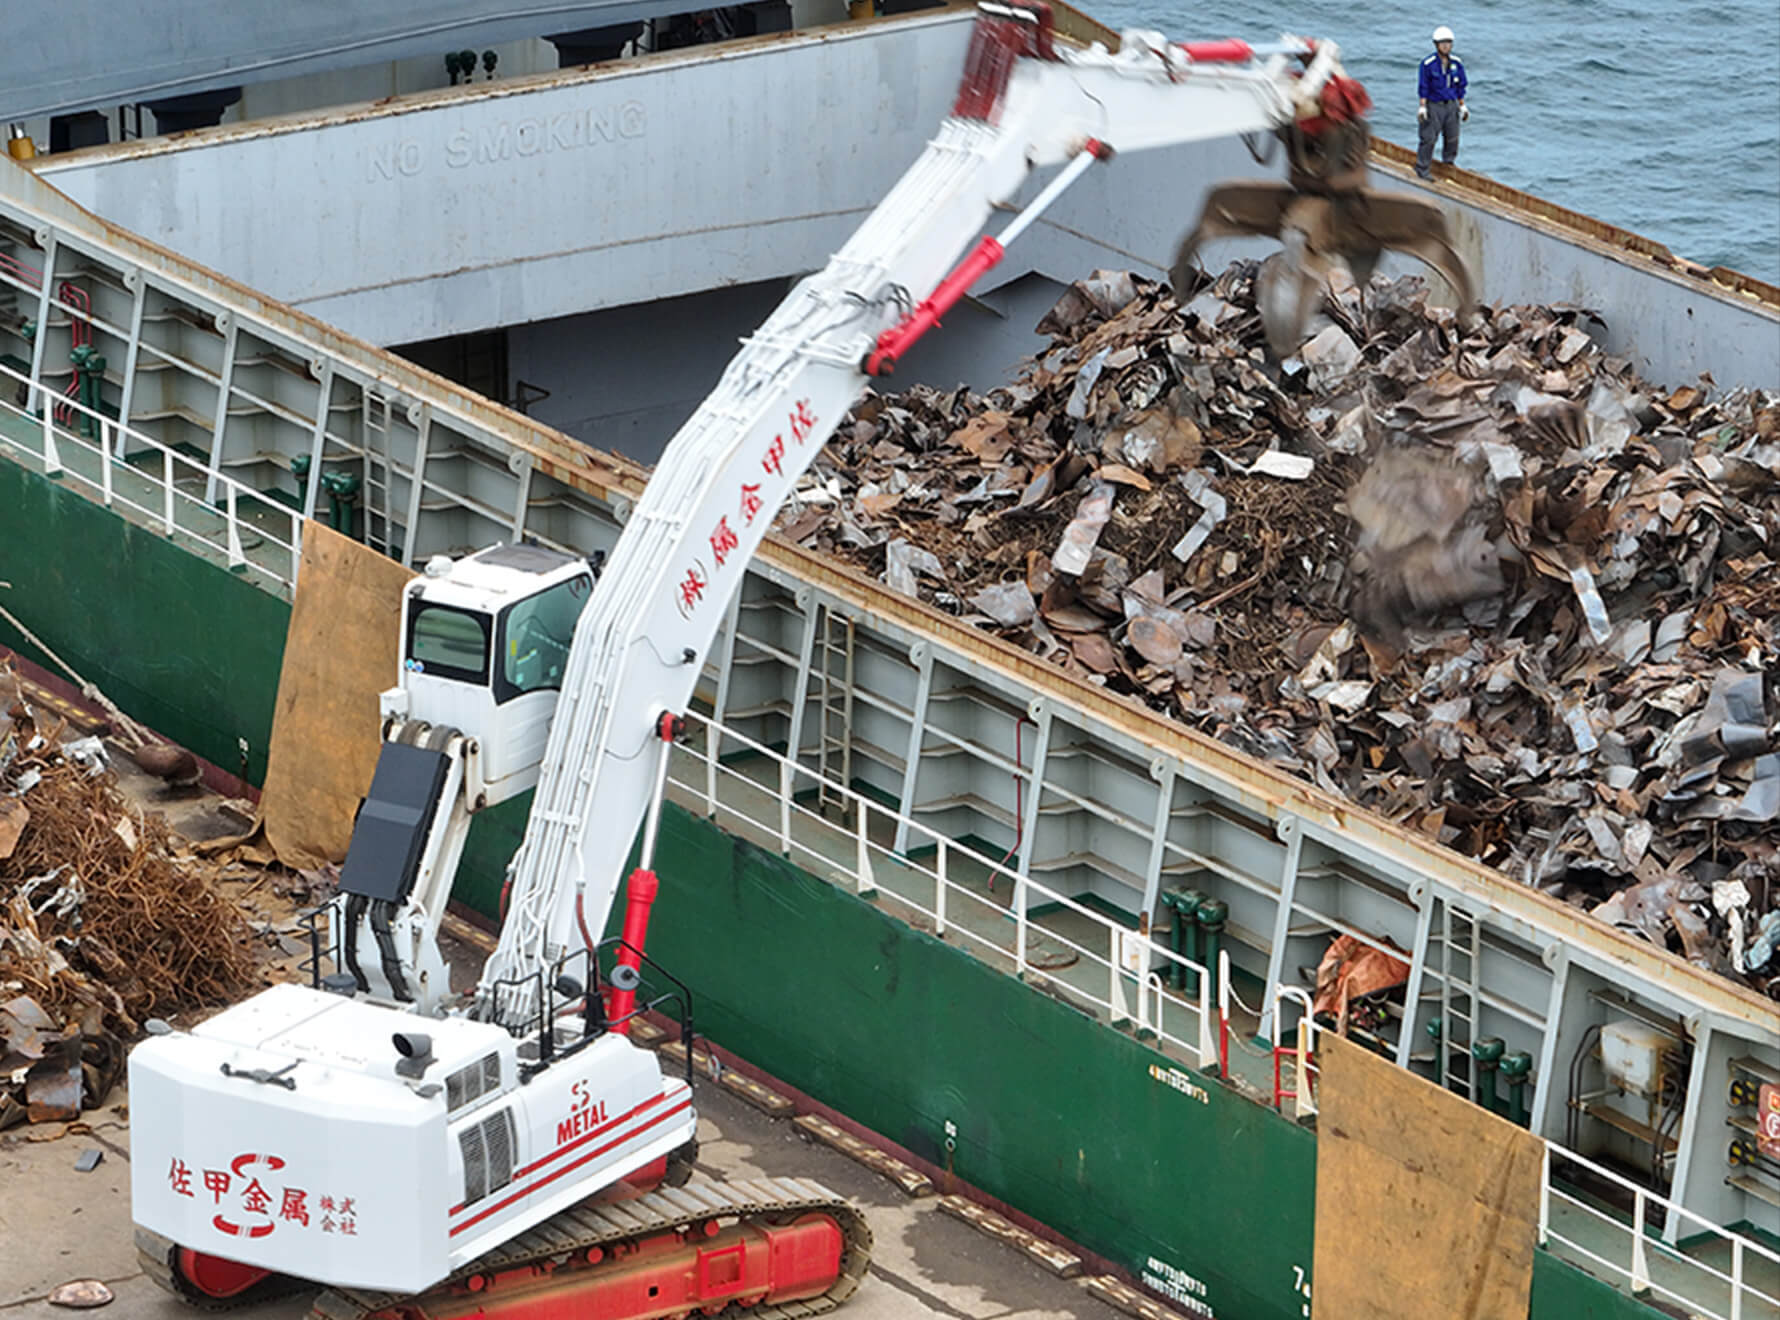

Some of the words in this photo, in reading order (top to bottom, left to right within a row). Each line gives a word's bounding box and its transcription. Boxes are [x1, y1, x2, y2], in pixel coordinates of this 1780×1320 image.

[365, 138, 425, 184] NO
[446, 100, 648, 169] SMOKING
[557, 1100, 608, 1145] METAL
[168, 1157, 310, 1227] 佐甲金属
